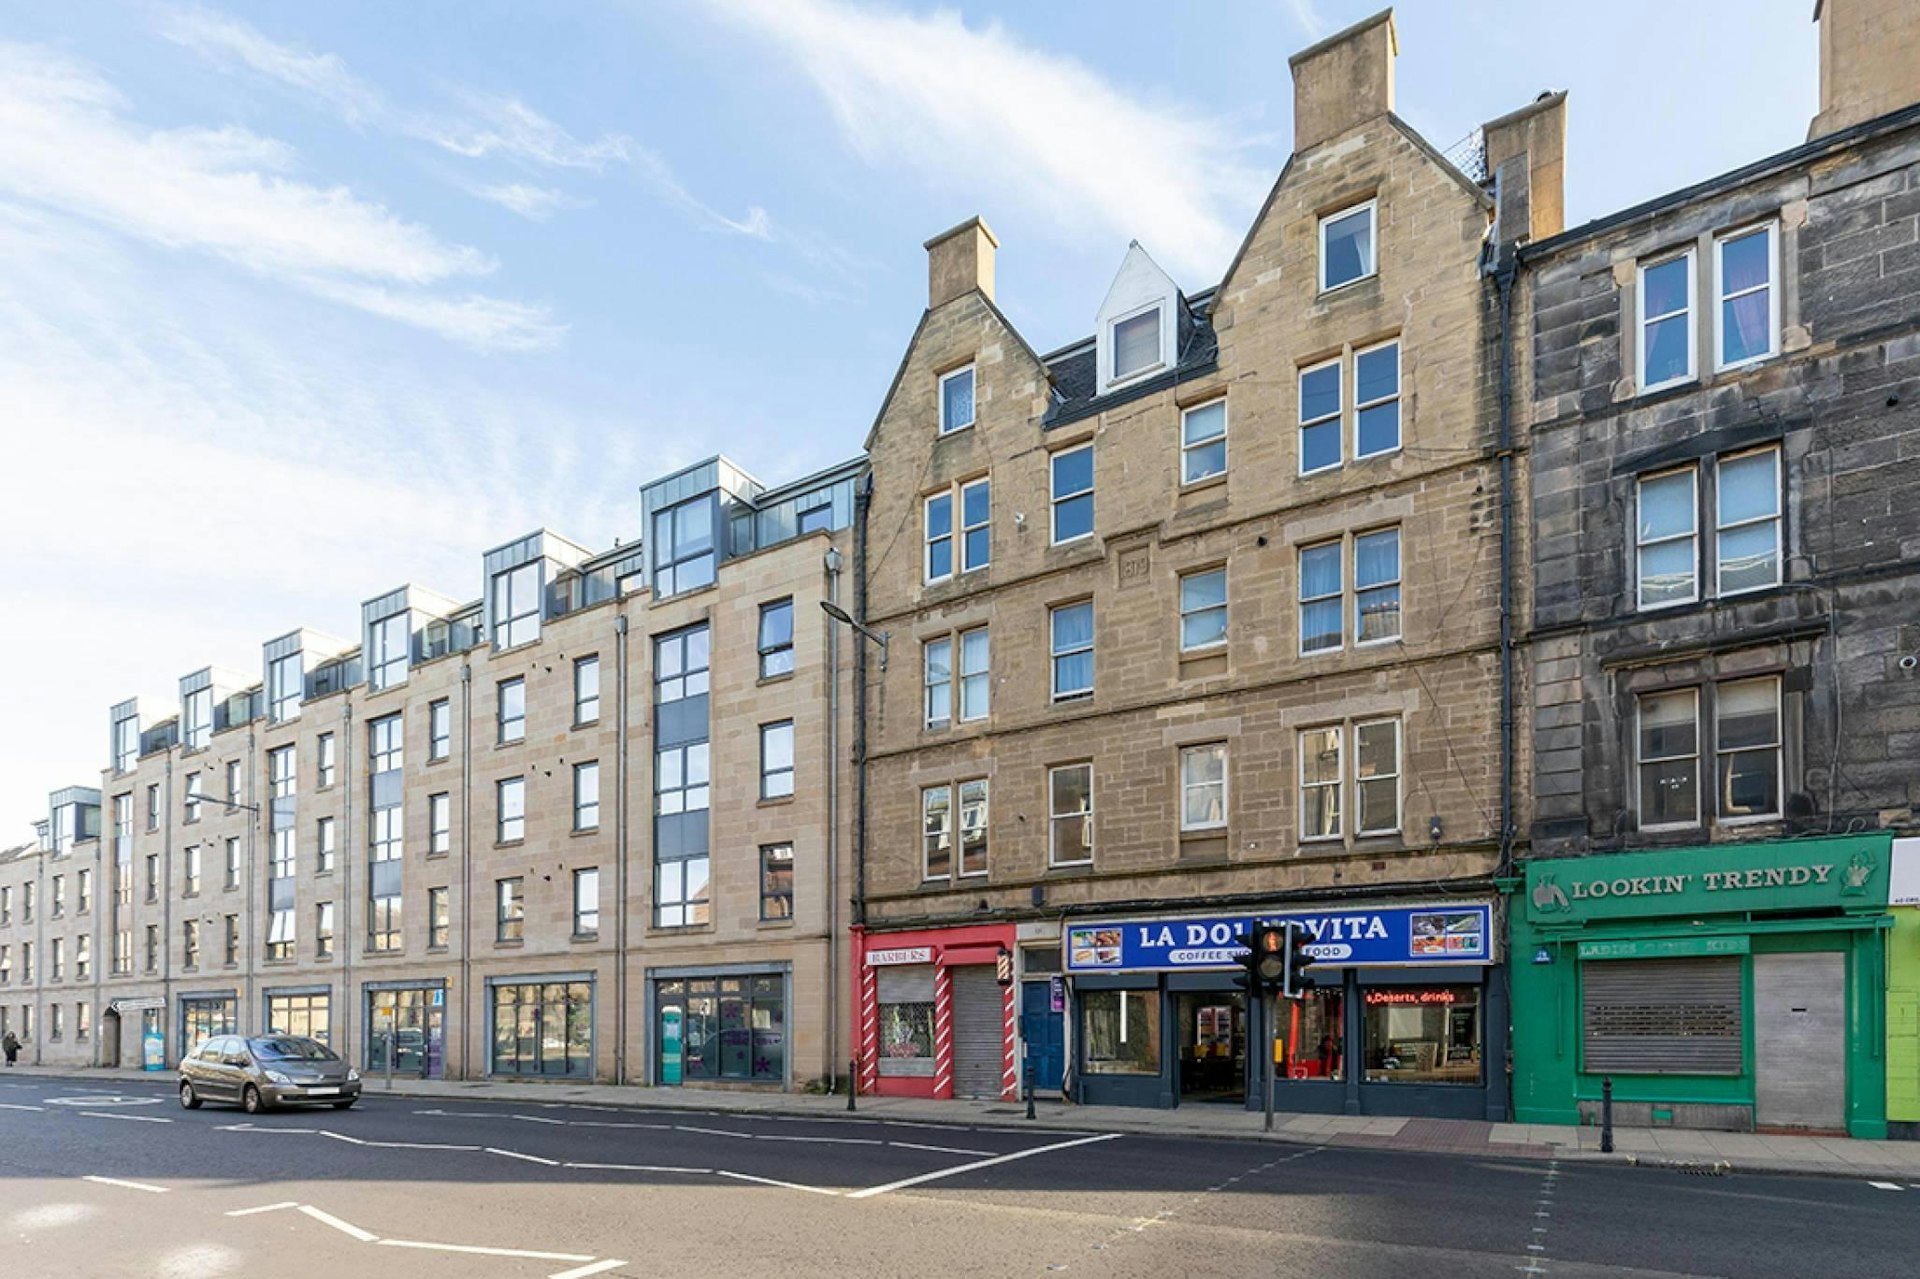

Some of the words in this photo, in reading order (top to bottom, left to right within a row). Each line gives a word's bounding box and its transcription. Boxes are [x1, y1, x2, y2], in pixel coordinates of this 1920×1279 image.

[1572, 875, 1692, 898] LOOKIN'
[1703, 864, 1834, 890] TRENDY
[1139, 926, 1175, 947] LA
[1178, 950, 1222, 961] COFFEE
[1305, 946, 1341, 957] FOOD
[1579, 943, 1637, 956] LADIES
